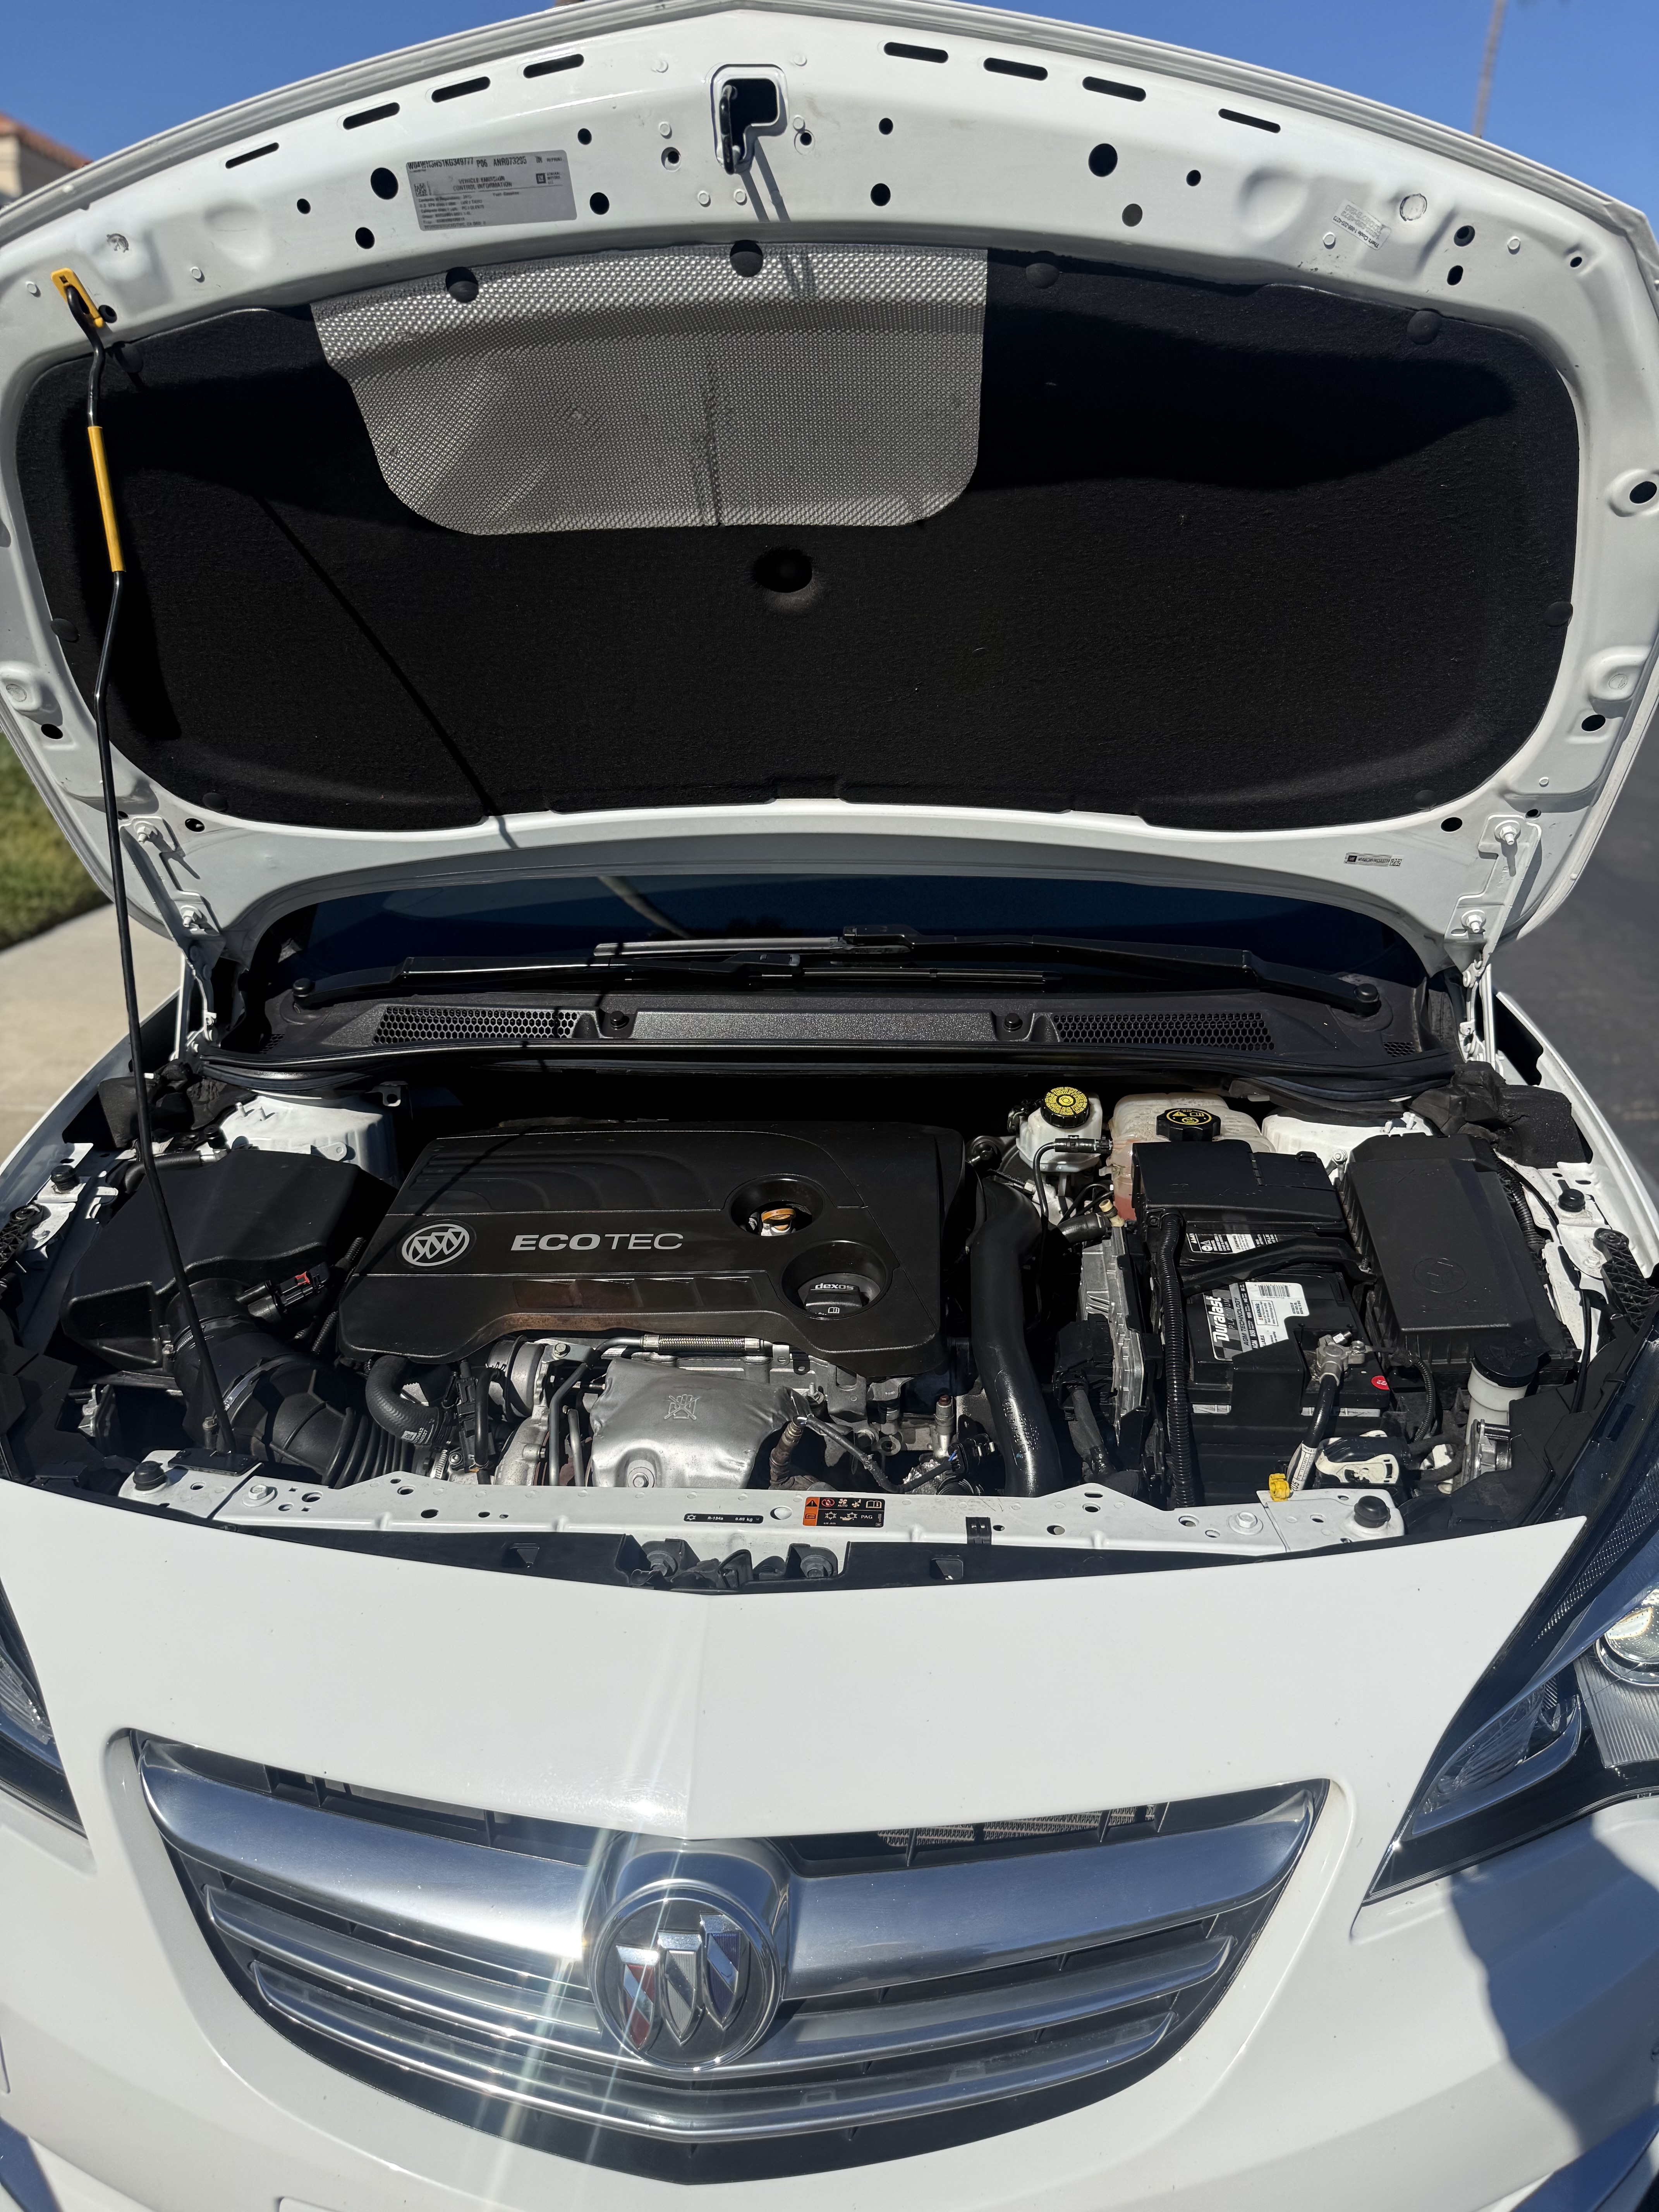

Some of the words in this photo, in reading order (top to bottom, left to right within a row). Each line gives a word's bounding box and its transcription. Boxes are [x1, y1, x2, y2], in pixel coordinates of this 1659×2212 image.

[476, 159, 488, 168] P06
[493, 156, 527, 167] ANR073295
[1358, 231, 1368, 240] Code
[1368, 239, 1379, 248] Theft
[510, 1233, 684, 1251] ECOTEC
[1206, 1296, 1230, 1343] Duralast
[1234, 1297, 1246, 1331] TECHNOLOGY
